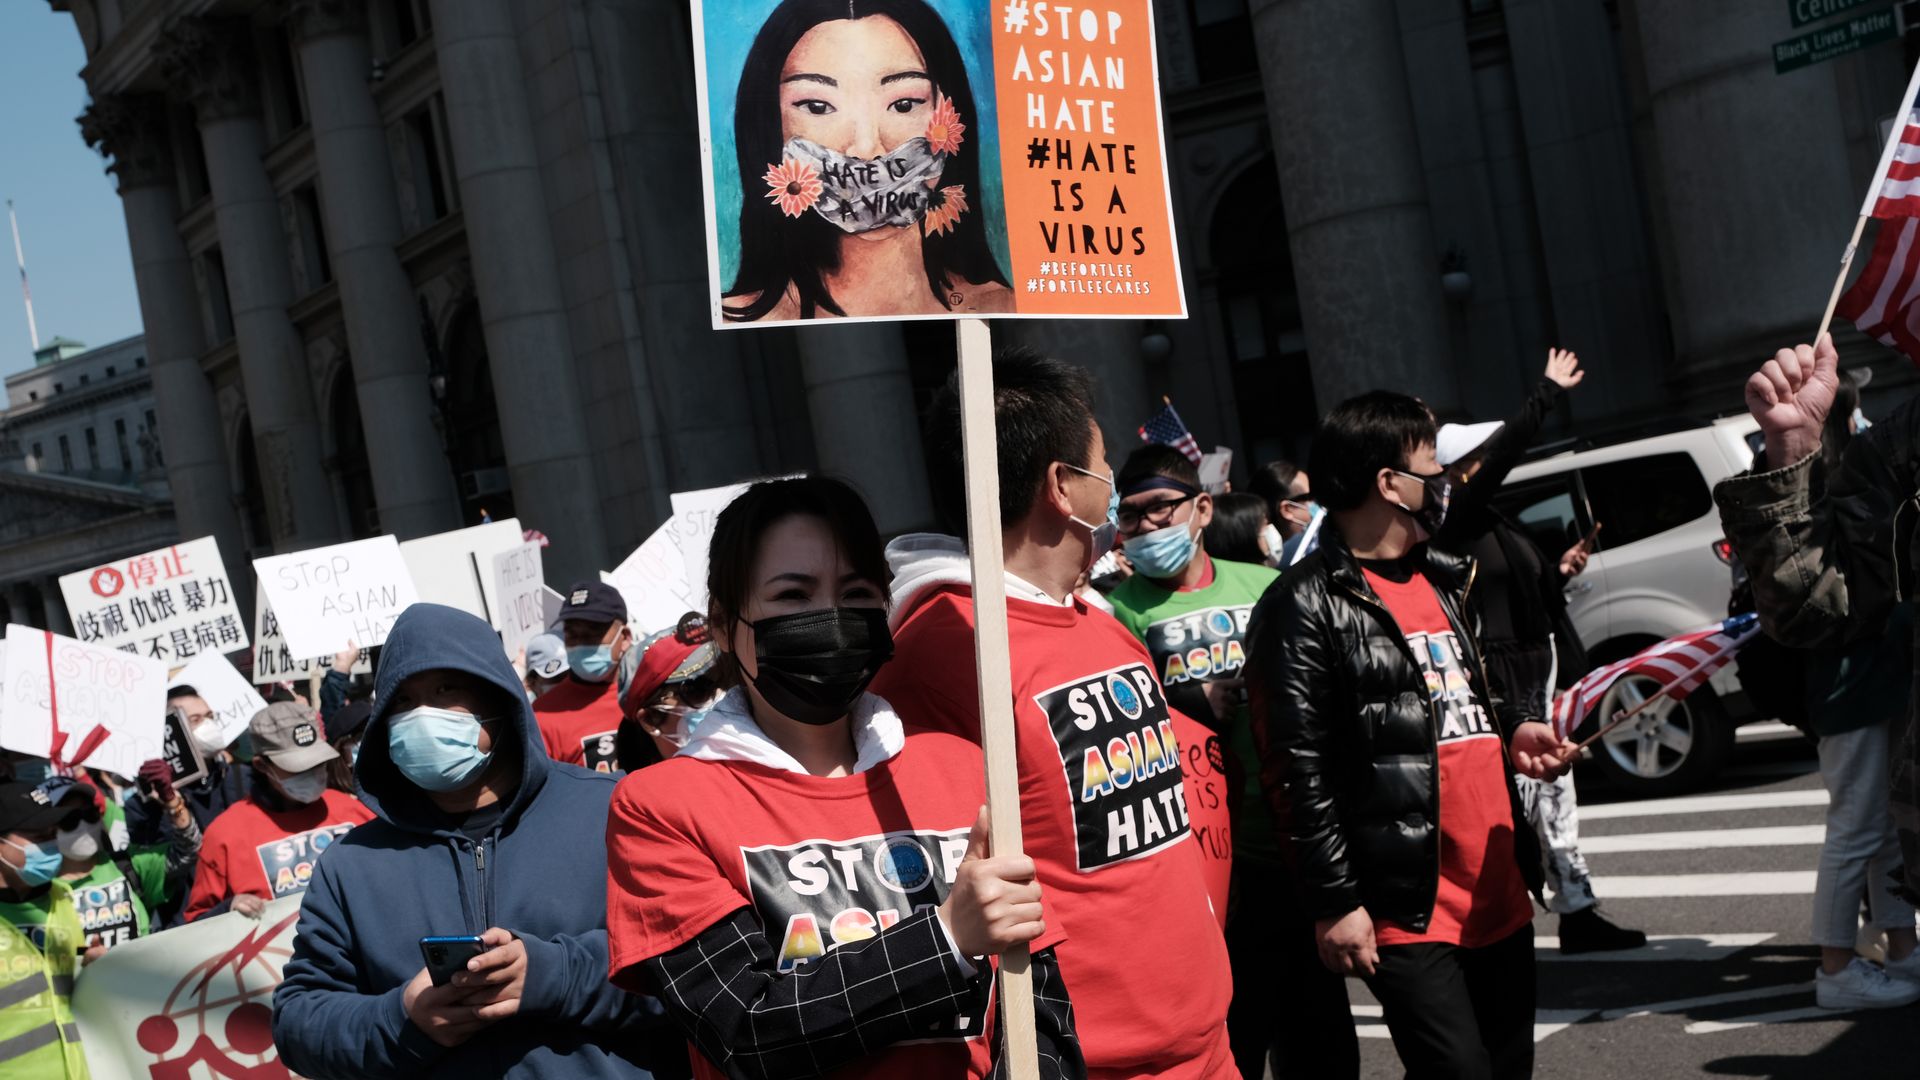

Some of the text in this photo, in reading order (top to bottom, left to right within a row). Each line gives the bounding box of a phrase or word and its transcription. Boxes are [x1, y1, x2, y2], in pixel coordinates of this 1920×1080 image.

[1004, 0, 1122, 44] #STOP
[1813, 28, 1847, 50] Lives
[1849, 13, 1891, 38] Matter
[1012, 45, 1125, 89] ASIAN
[1027, 93, 1115, 134] HATE
[822, 158, 907, 189] HATE IS
[1027, 137, 1136, 174] #HATE
[839, 191, 920, 222] A VIRUS
[1051, 180, 1127, 214] IS A
[1039, 221, 1145, 256] VIRUS
[1027, 278, 1150, 295] #FORTLEECARES
[1040, 261, 1133, 278] #BEFORTLEE
[128, 546, 193, 589] 停止
[278, 555, 350, 591] STOP
[322, 584, 397, 617] ASIAN
[1163, 609, 1252, 646] STOP
[1068, 671, 1155, 732] STOP
[1081, 717, 1180, 804] ASIAN
[1195, 779, 1219, 810] is
[1107, 782, 1190, 858] HATE
